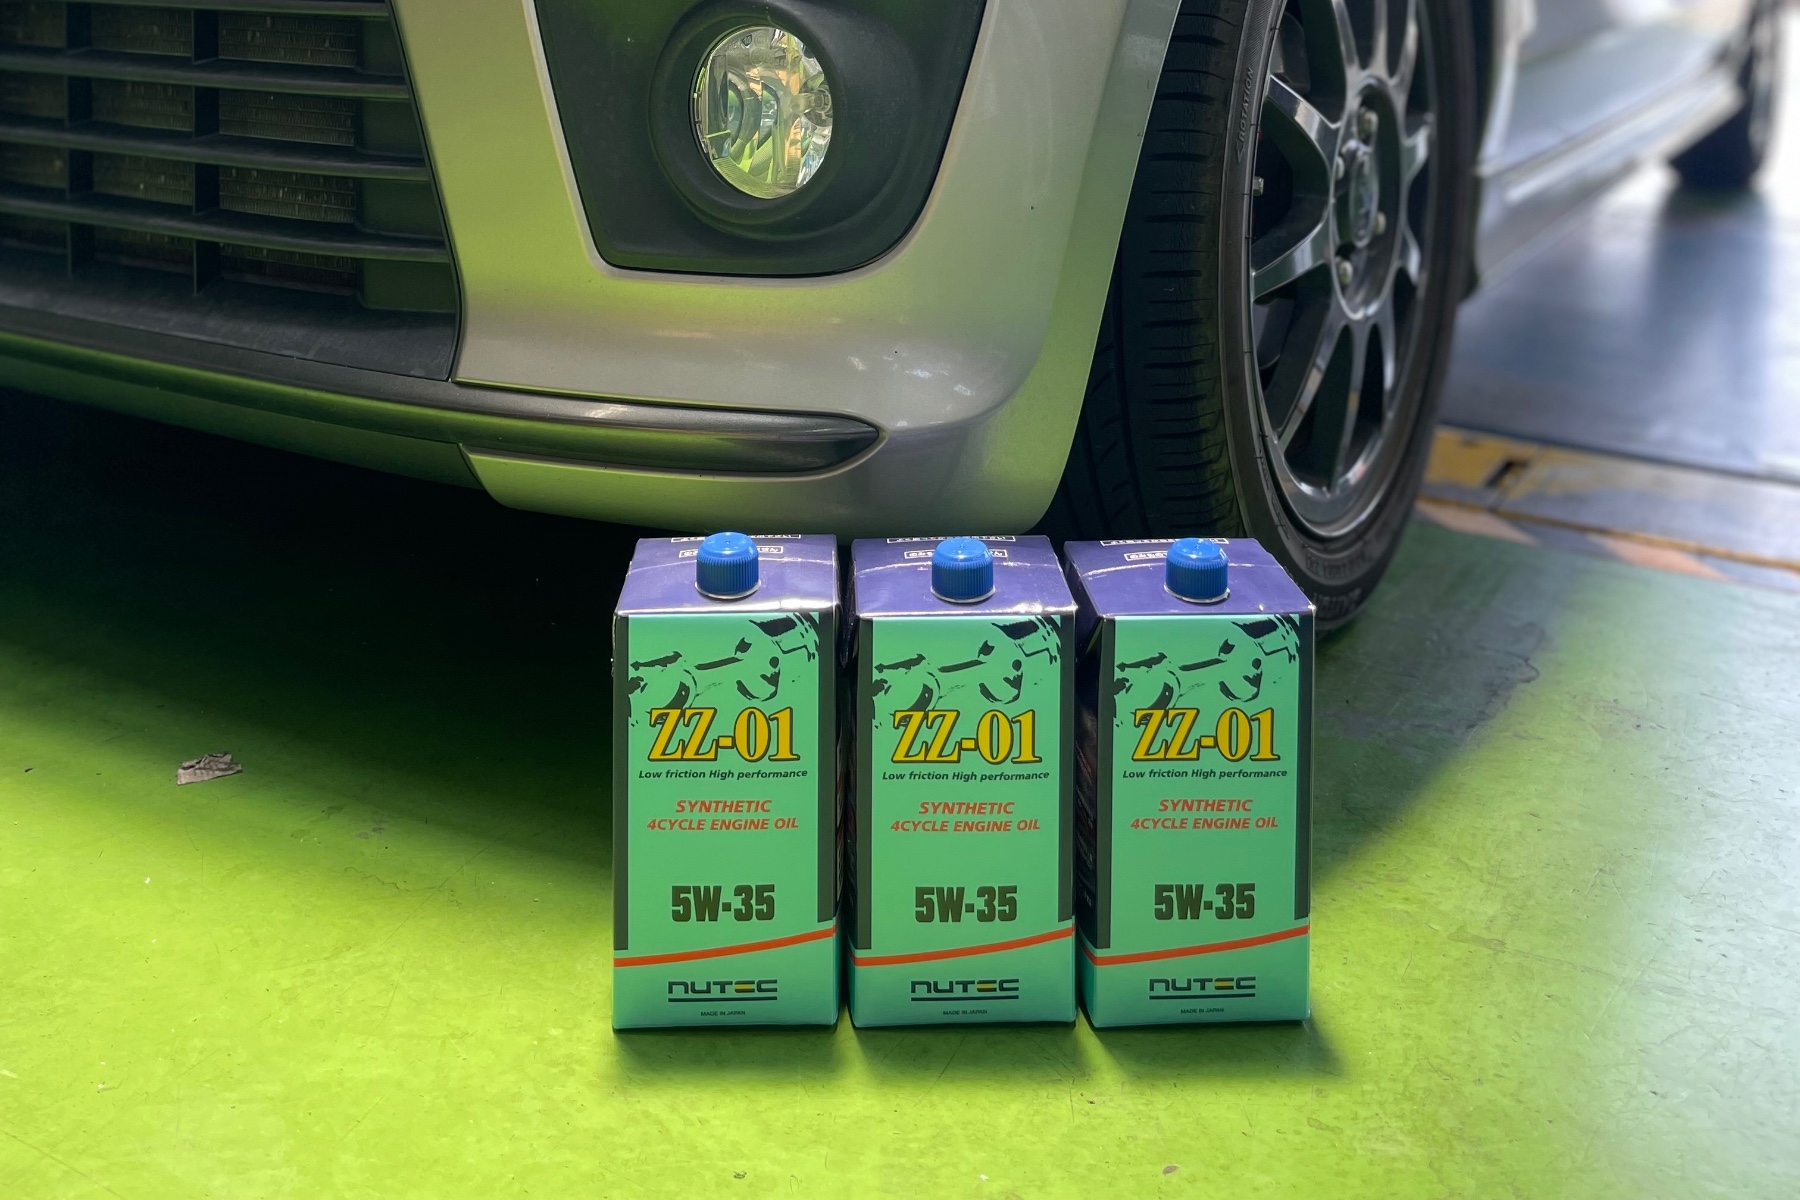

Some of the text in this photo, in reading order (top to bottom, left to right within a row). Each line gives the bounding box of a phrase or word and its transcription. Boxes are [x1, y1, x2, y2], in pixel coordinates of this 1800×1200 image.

[1238, 66, 1254, 142] ROTATION
[648, 707, 801, 762] ZZ-01
[891, 709, 1042, 765] ZZ-01
[1131, 707, 1281, 762] ZZ-01
[638, 769, 808, 780] Low friction High performance
[882, 771, 1050, 782] Low friction High performance
[1122, 768, 1288, 780] Low friction High performance
[675, 799, 772, 813] SYNTHETIC
[919, 801, 1015, 815] SYNTHETIC
[1158, 799, 1253, 812] SYNTHETIC
[647, 817, 799, 831] 4CYCLE ENGINE OIL
[890, 819, 1040, 832] 4CYCLE ENGINE OIL
[1130, 817, 1279, 830] 4CYCLE ENGINE OIL
[671, 884, 775, 922] 5W-35
[915, 885, 1018, 923] 5W-35
[1154, 883, 1256, 921] 5W-35
[667, 979, 778, 994] NUTEC
[911, 978, 1019, 994] NUTEC
[1149, 976, 1256, 992] NUTEC
